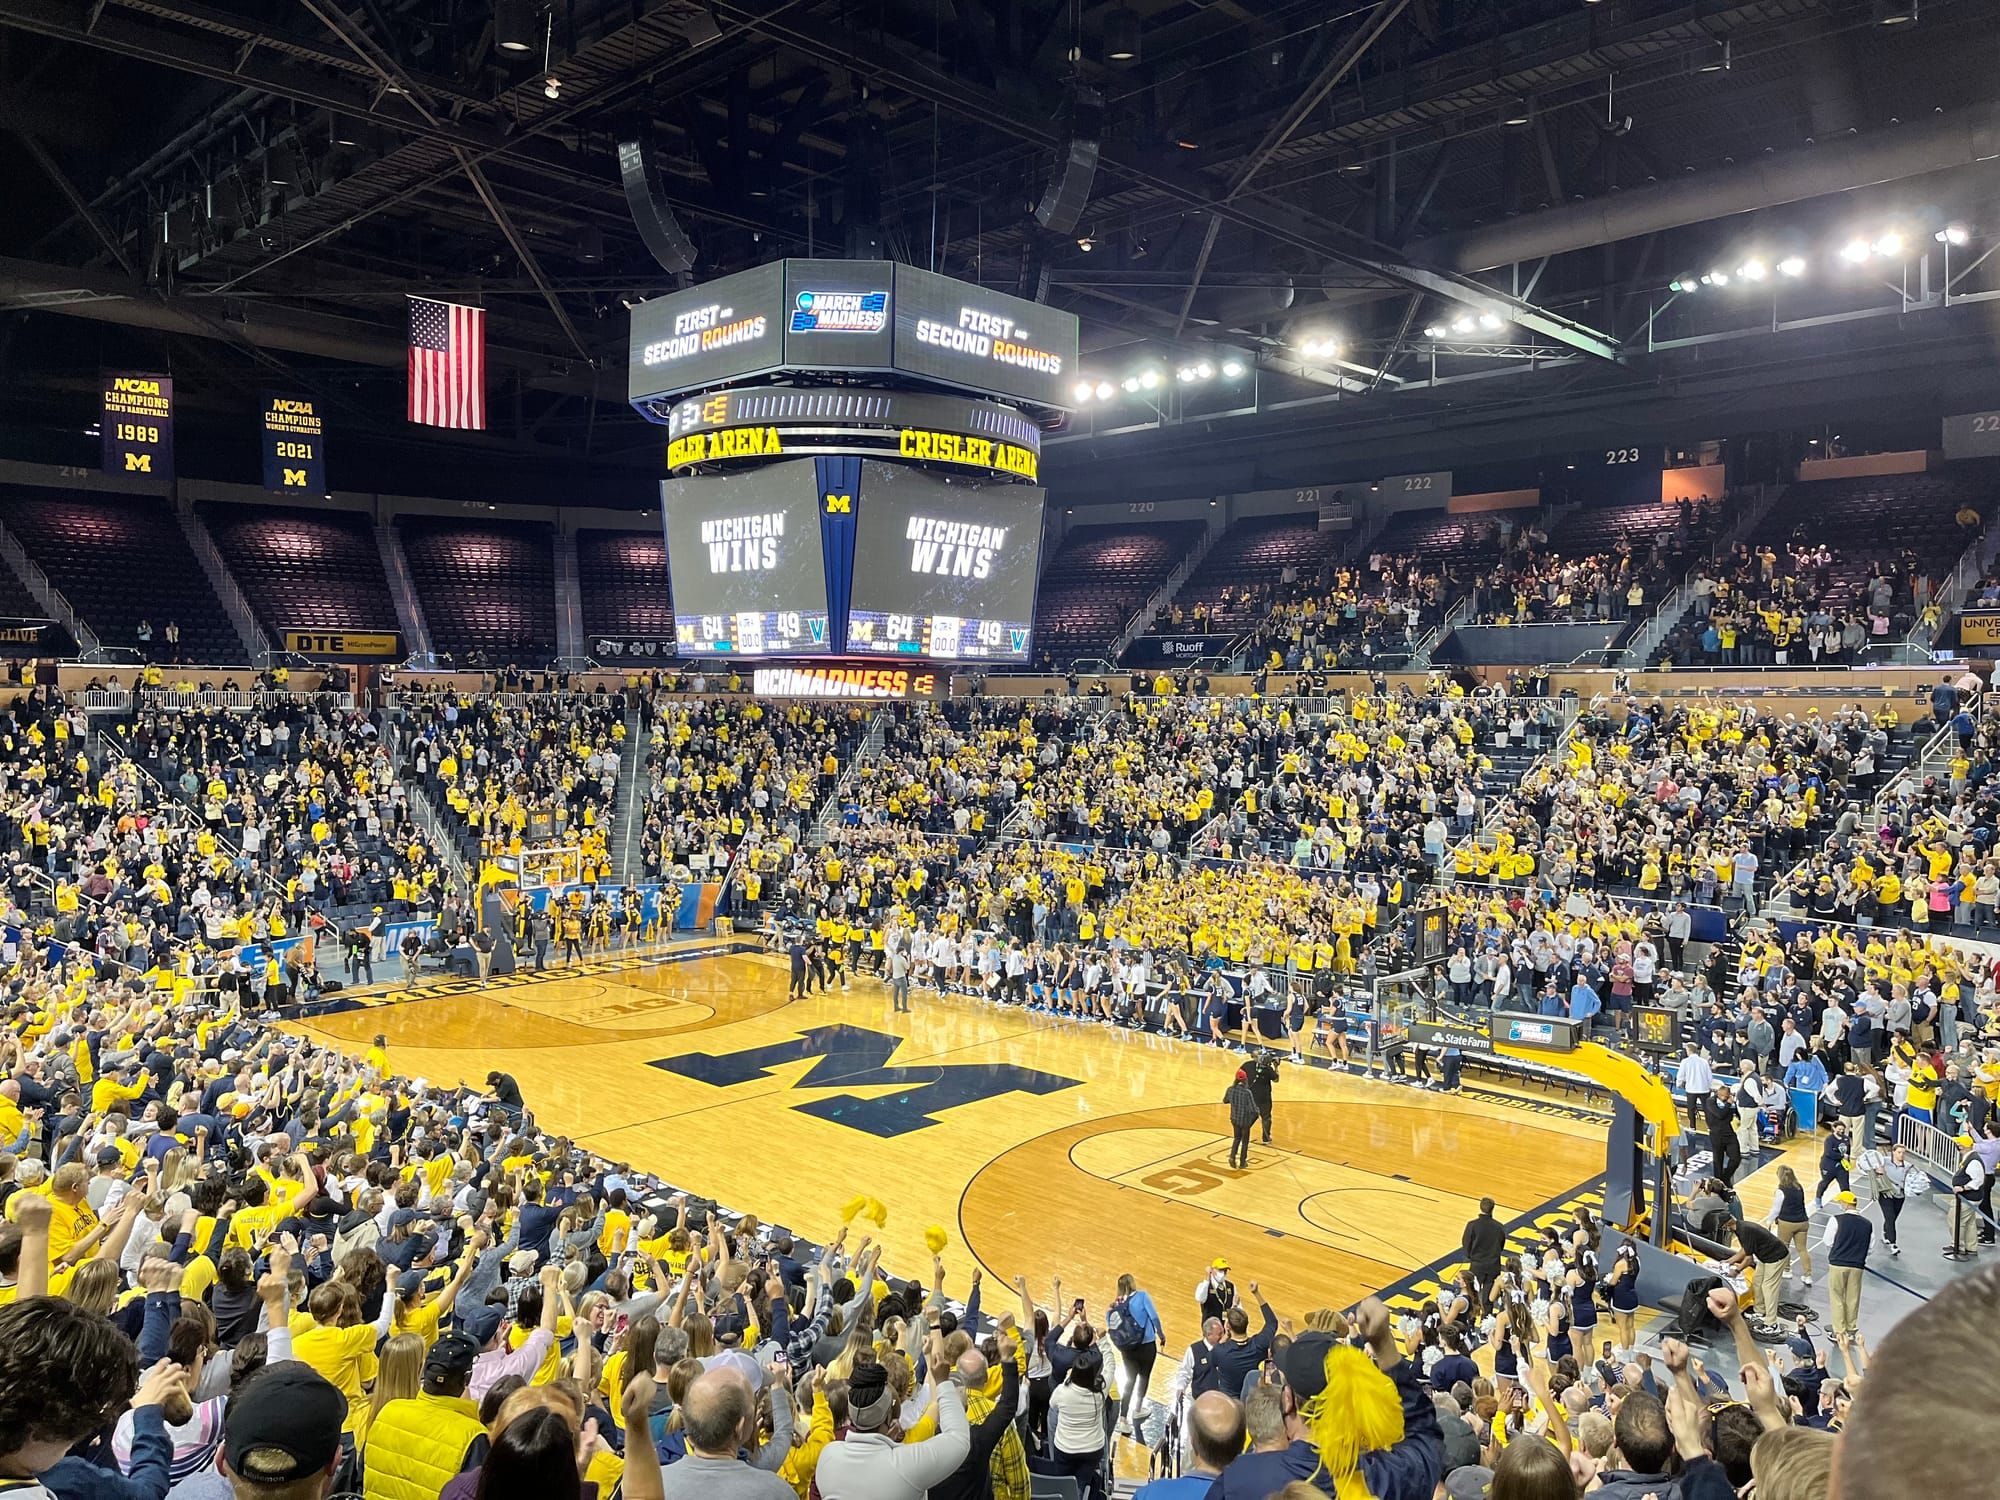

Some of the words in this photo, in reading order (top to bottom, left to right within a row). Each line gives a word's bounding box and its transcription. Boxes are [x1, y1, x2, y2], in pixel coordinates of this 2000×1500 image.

[812, 294, 862, 310] MARCH
[674, 304, 720, 335] FIRST
[818, 311, 884, 327] MADNESS
[958, 307, 1013, 339] FIRST
[643, 333, 699, 366] SECOND
[701, 316, 766, 351] ROUNDS
[915, 319, 990, 357] SECOND
[992, 339, 1062, 375] ROUNDS
[114, 378, 159, 395] NCAA
[105, 392, 169, 409] CHAMPIONS
[273, 399, 313, 415] NCAA
[105, 403, 126, 413] MEN'S
[127, 406, 169, 417] BASKETBALL
[265, 412, 321, 427] CHAMPIONS
[117, 424, 158, 443] 1989
[709, 426, 783, 458] ARENA
[277, 441, 312, 459] 2021
[900, 428, 992, 466] CRISLER
[994, 444, 1038, 478] ARENA
[1606, 448, 1639, 464] 223
[125, 453, 151, 472] M
[60, 466, 88, 478] 214
[284, 468, 306, 486] M
[1405, 477, 1431, 490] 222
[826, 495, 850, 513] M
[1296, 489, 1320, 502] 221
[1129, 502, 1154, 512] 220
[701, 513, 784, 543] MICHIGAN
[905, 516, 1005, 550] MICHIGAN
[709, 537, 776, 573] WINS
[910, 540, 992, 578] WINS
[702, 616, 724, 640] 64
[778, 612, 799, 638] 49
[886, 615, 913, 640] 64
[977, 621, 1001, 646] 49
[297, 635, 344, 651] DTE
[1175, 642, 1204, 652] Ruoff
[791, 669, 908, 697] MADNESS
[357, 957, 661, 1006] MICHIGAN
[644, 1023, 1087, 1138] M
